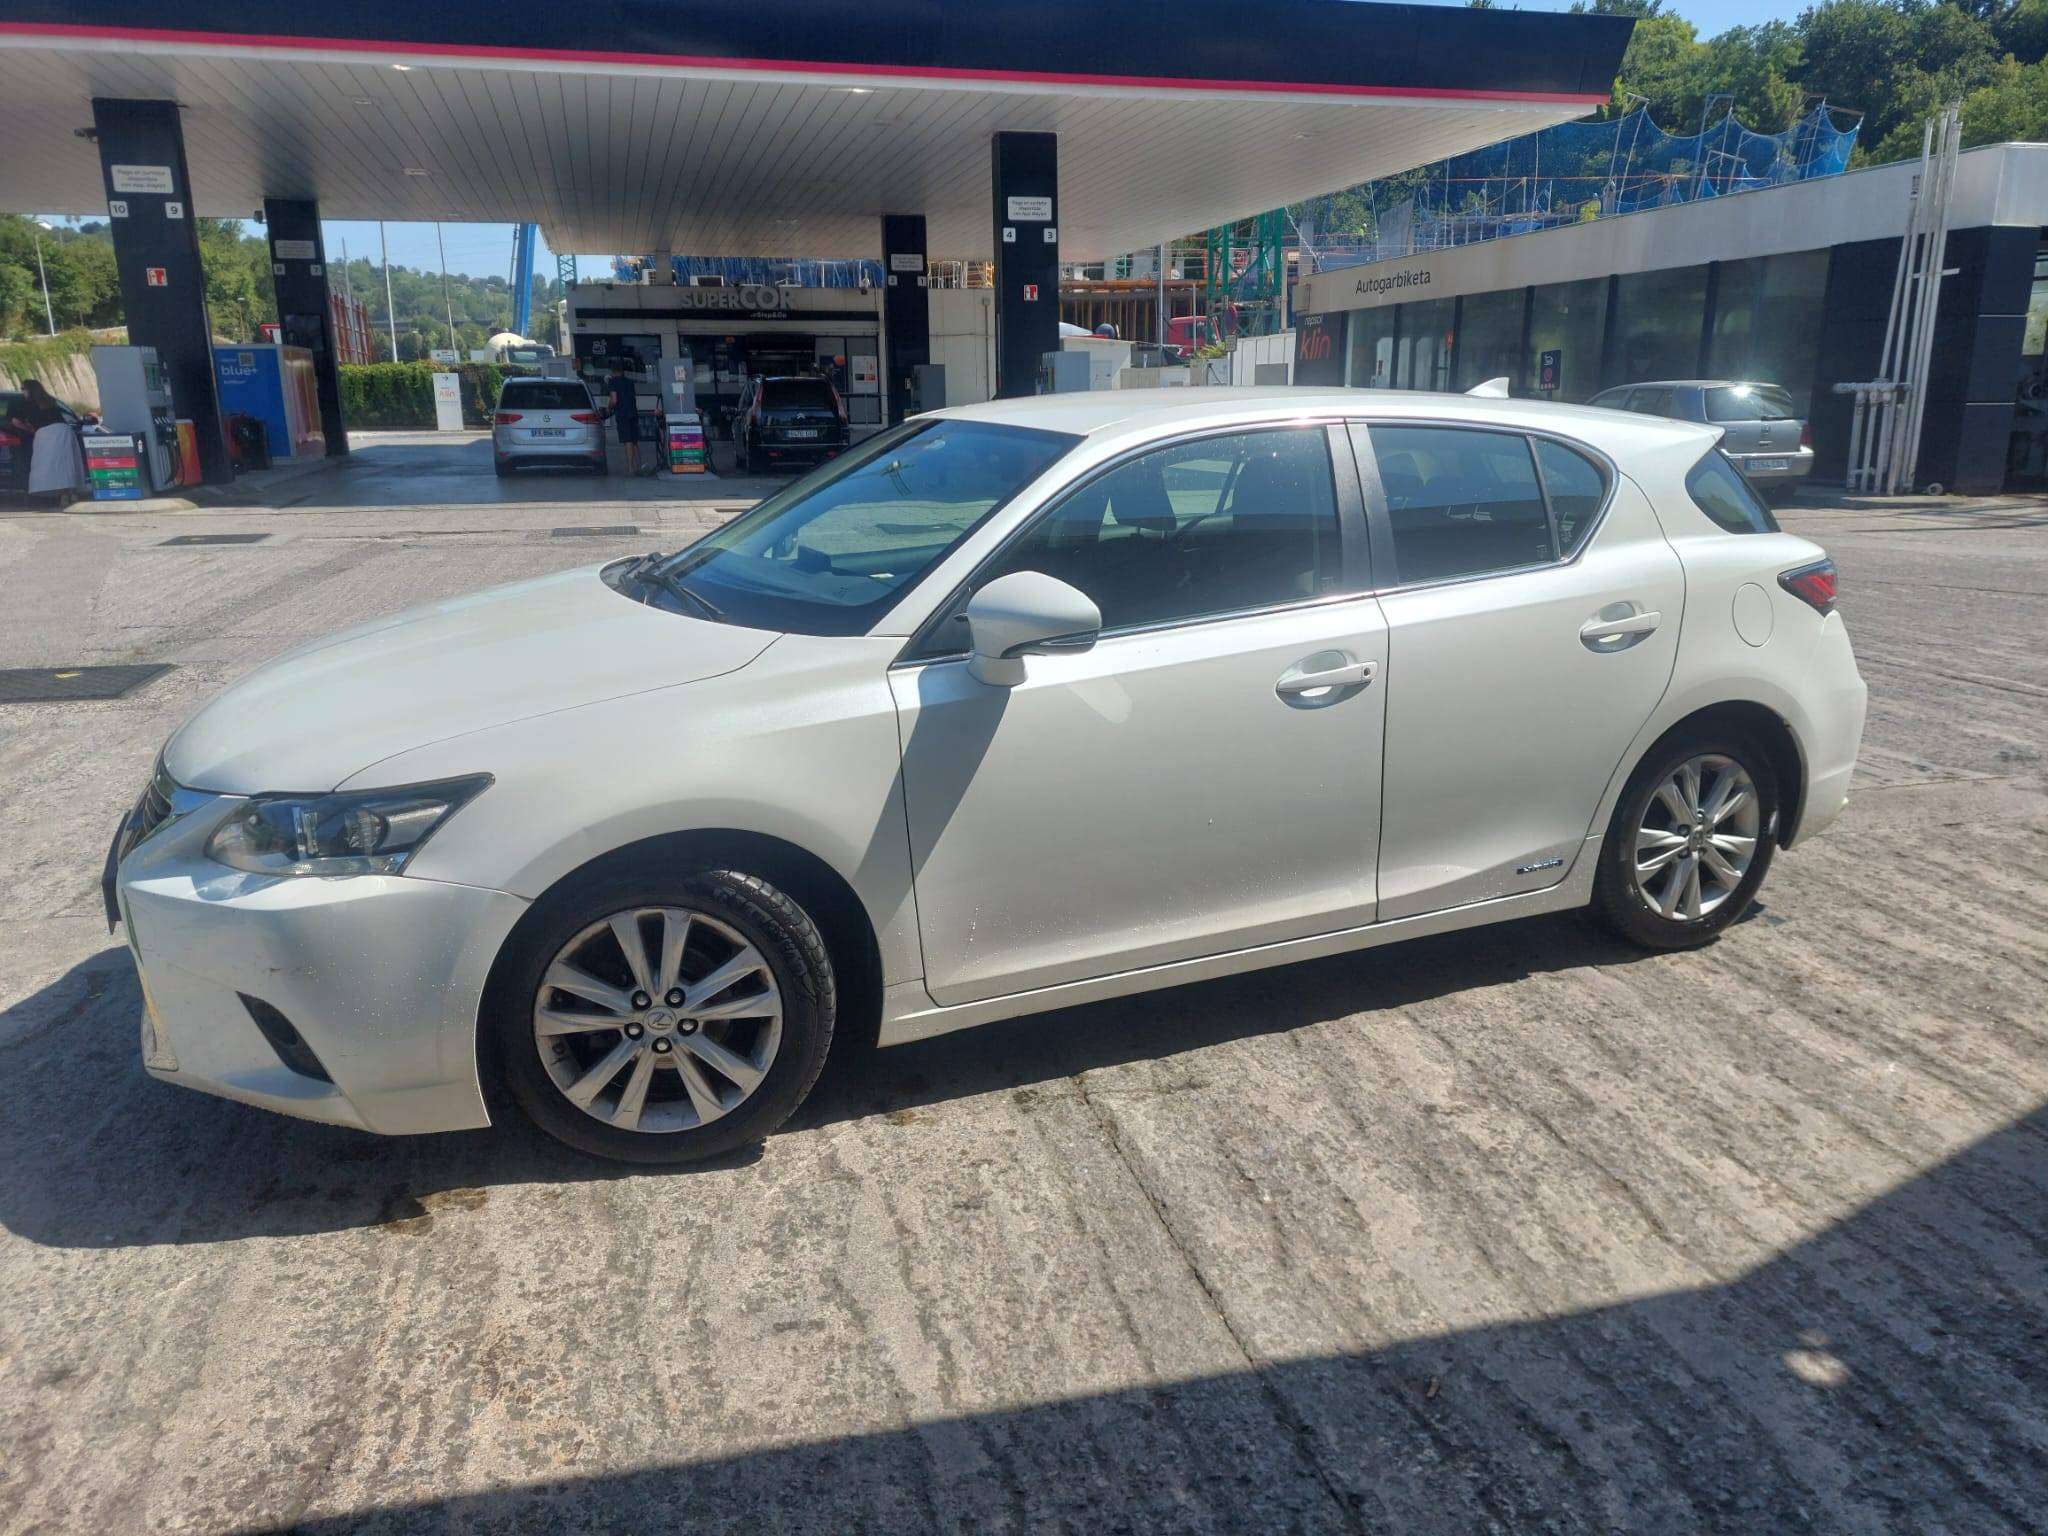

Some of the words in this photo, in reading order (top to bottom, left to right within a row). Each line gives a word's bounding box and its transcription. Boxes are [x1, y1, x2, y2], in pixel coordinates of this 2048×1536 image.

[111, 204, 126, 214] 10
[170, 205, 179, 215] 9
[1006, 231, 1012, 239] 4
[1047, 231, 1053, 240] 3
[1355, 270, 1431, 295] Autogarbiketa
[681, 287, 797, 310] SUPERCOR
[1300, 327, 1331, 360] klin
